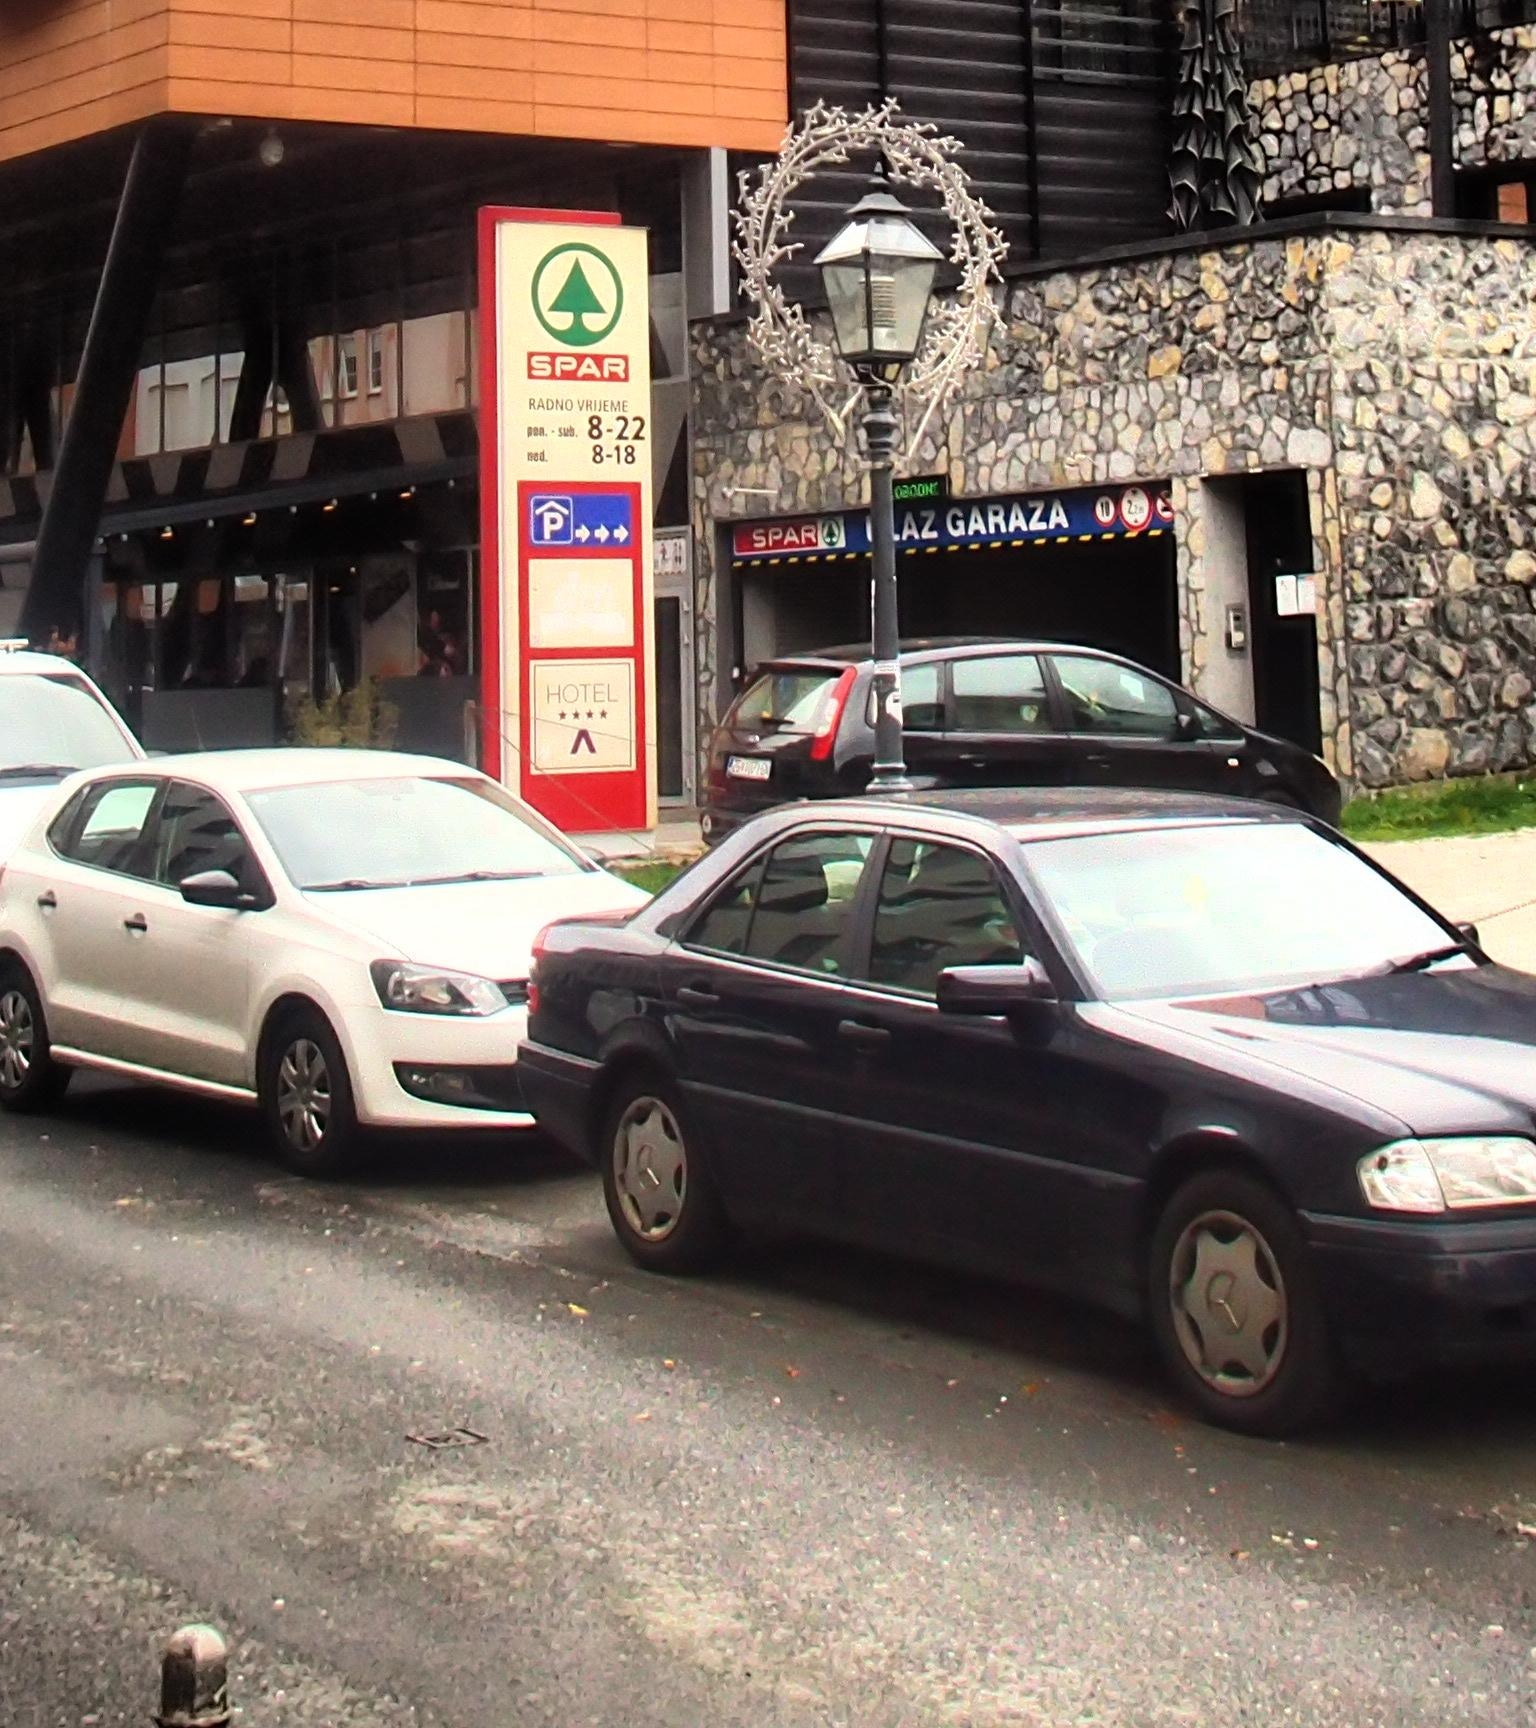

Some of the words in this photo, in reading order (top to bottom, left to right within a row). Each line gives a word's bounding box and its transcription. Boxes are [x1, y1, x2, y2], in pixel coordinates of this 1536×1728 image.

[531, 355, 626, 379] SPAR
[528, 397, 574, 412] RADNO
[577, 399, 629, 413] VRIJEME
[588, 415, 645, 440] 8-22
[592, 444, 636, 465] 8-18
[543, 512, 564, 540] P
[946, 498, 1070, 538] GARAZA
[752, 524, 818, 549] SPAR
[546, 683, 619, 704] HOTEL
